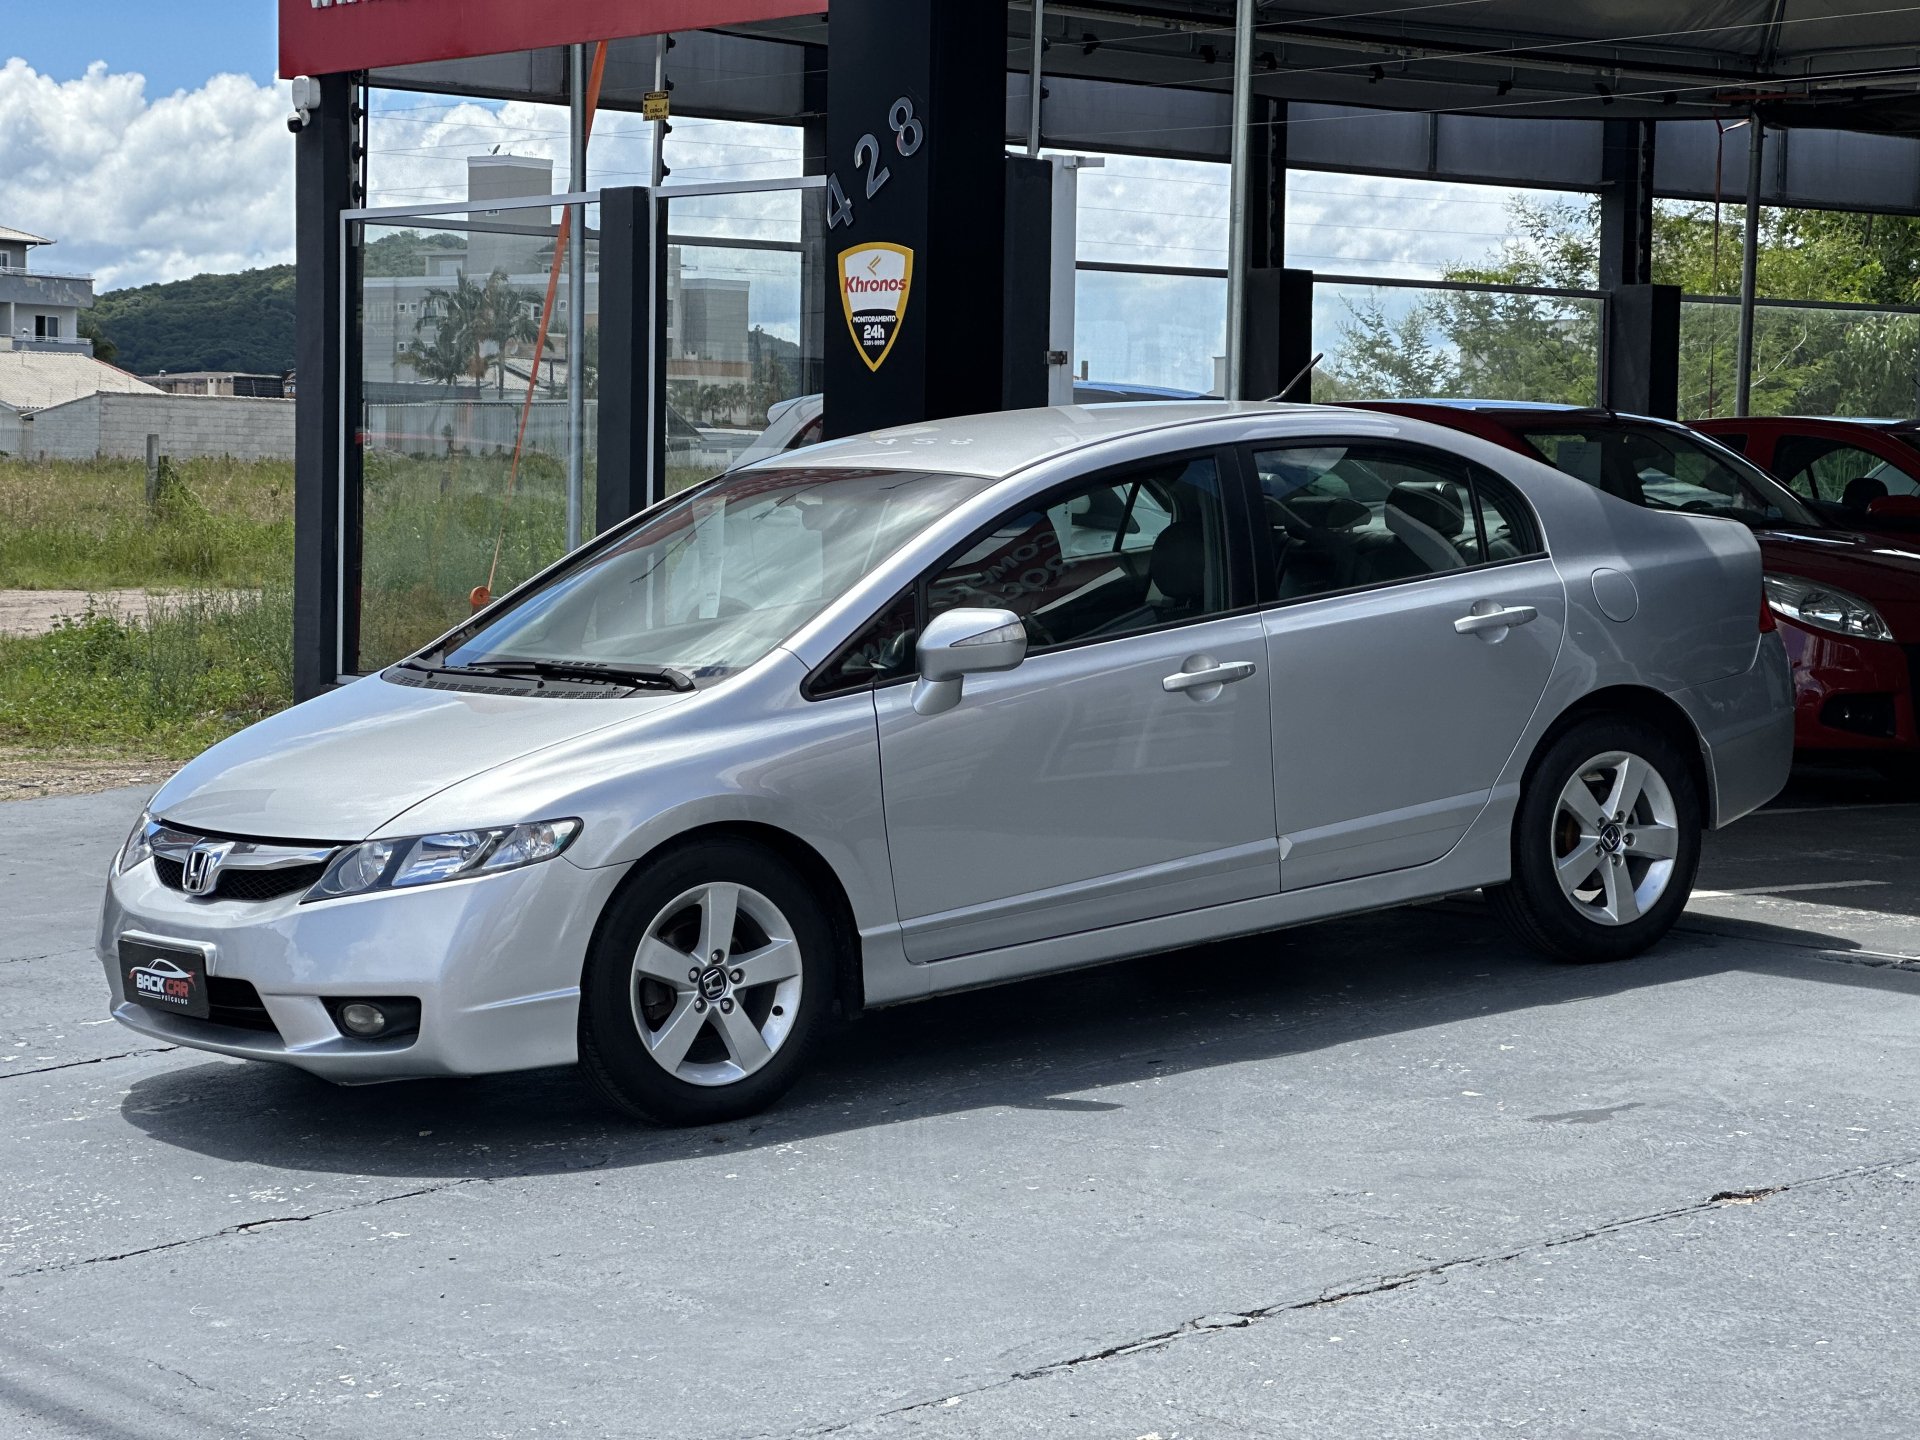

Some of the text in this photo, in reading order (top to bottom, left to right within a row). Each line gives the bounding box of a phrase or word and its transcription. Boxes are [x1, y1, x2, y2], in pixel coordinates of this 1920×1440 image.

[827, 96, 924, 230] 428
[844, 276, 907, 294] Khronos
[852, 315, 896, 323] MONITORAMENTO
[863, 324, 885, 339] 24h
[136, 972, 189, 998] BACK CAR
